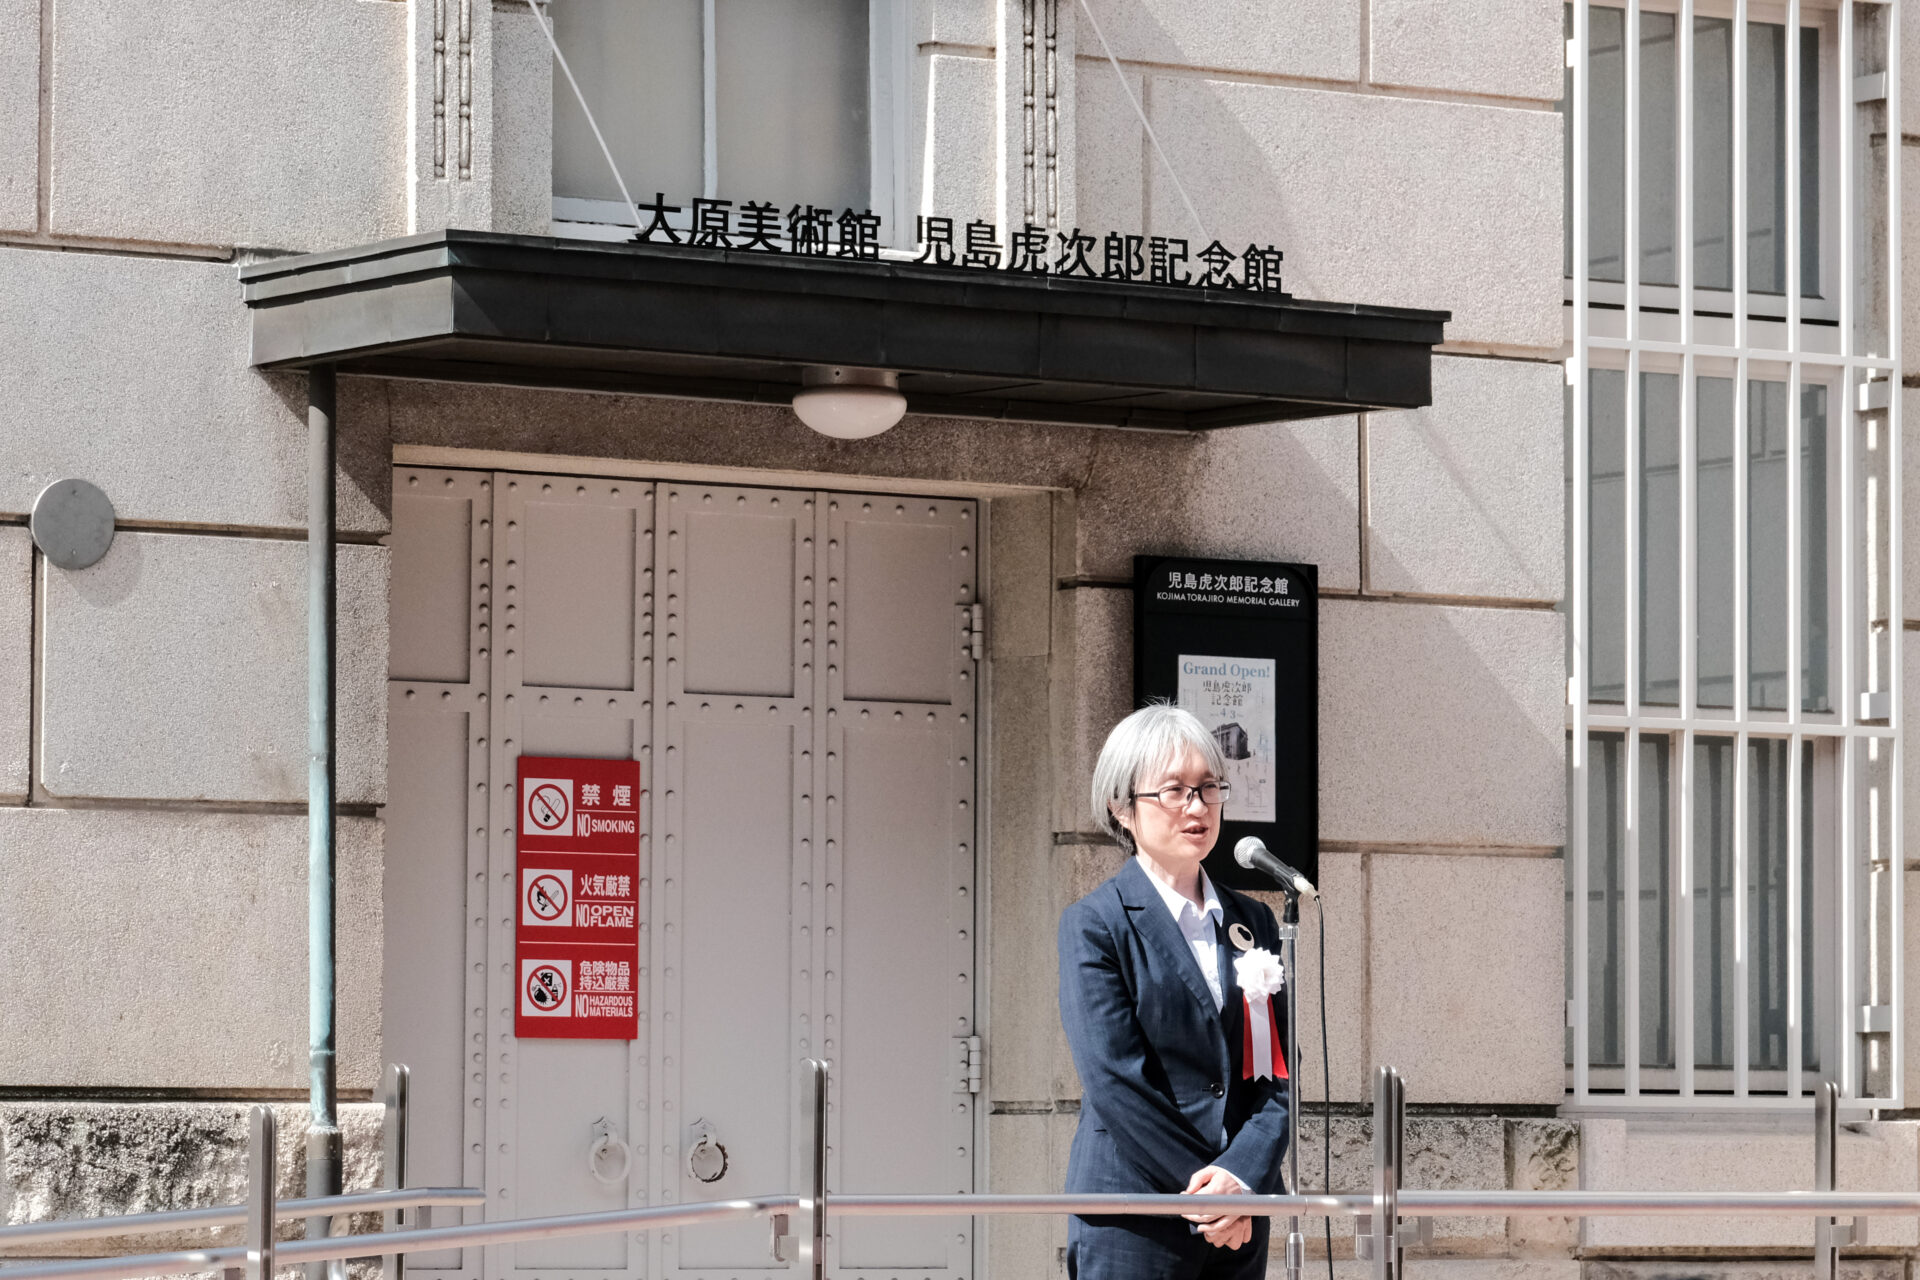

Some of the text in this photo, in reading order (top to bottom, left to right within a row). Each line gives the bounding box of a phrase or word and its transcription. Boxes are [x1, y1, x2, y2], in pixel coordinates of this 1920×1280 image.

[637, 192, 1284, 295] 大原美術館 児島虎次郎記念館
[1168, 571, 1289, 595] 児島虎次郎記念館
[1156, 592, 1300, 608] KOJIMA TORAJIRO MEMORIAL GALLERY
[1183, 661, 1270, 680] Grand Open!
[577, 813, 635, 838] NO SMOKING
[580, 873, 631, 898] 火気厳禁
[576, 903, 634, 928] NO OPEN
[590, 915, 634, 928] FLAME
[579, 960, 631, 977] 危険物品
[579, 975, 630, 991] 持込厳禁
[575, 993, 633, 1018] NO HAZARDOUS
[589, 1006, 633, 1018] MATERIALS
